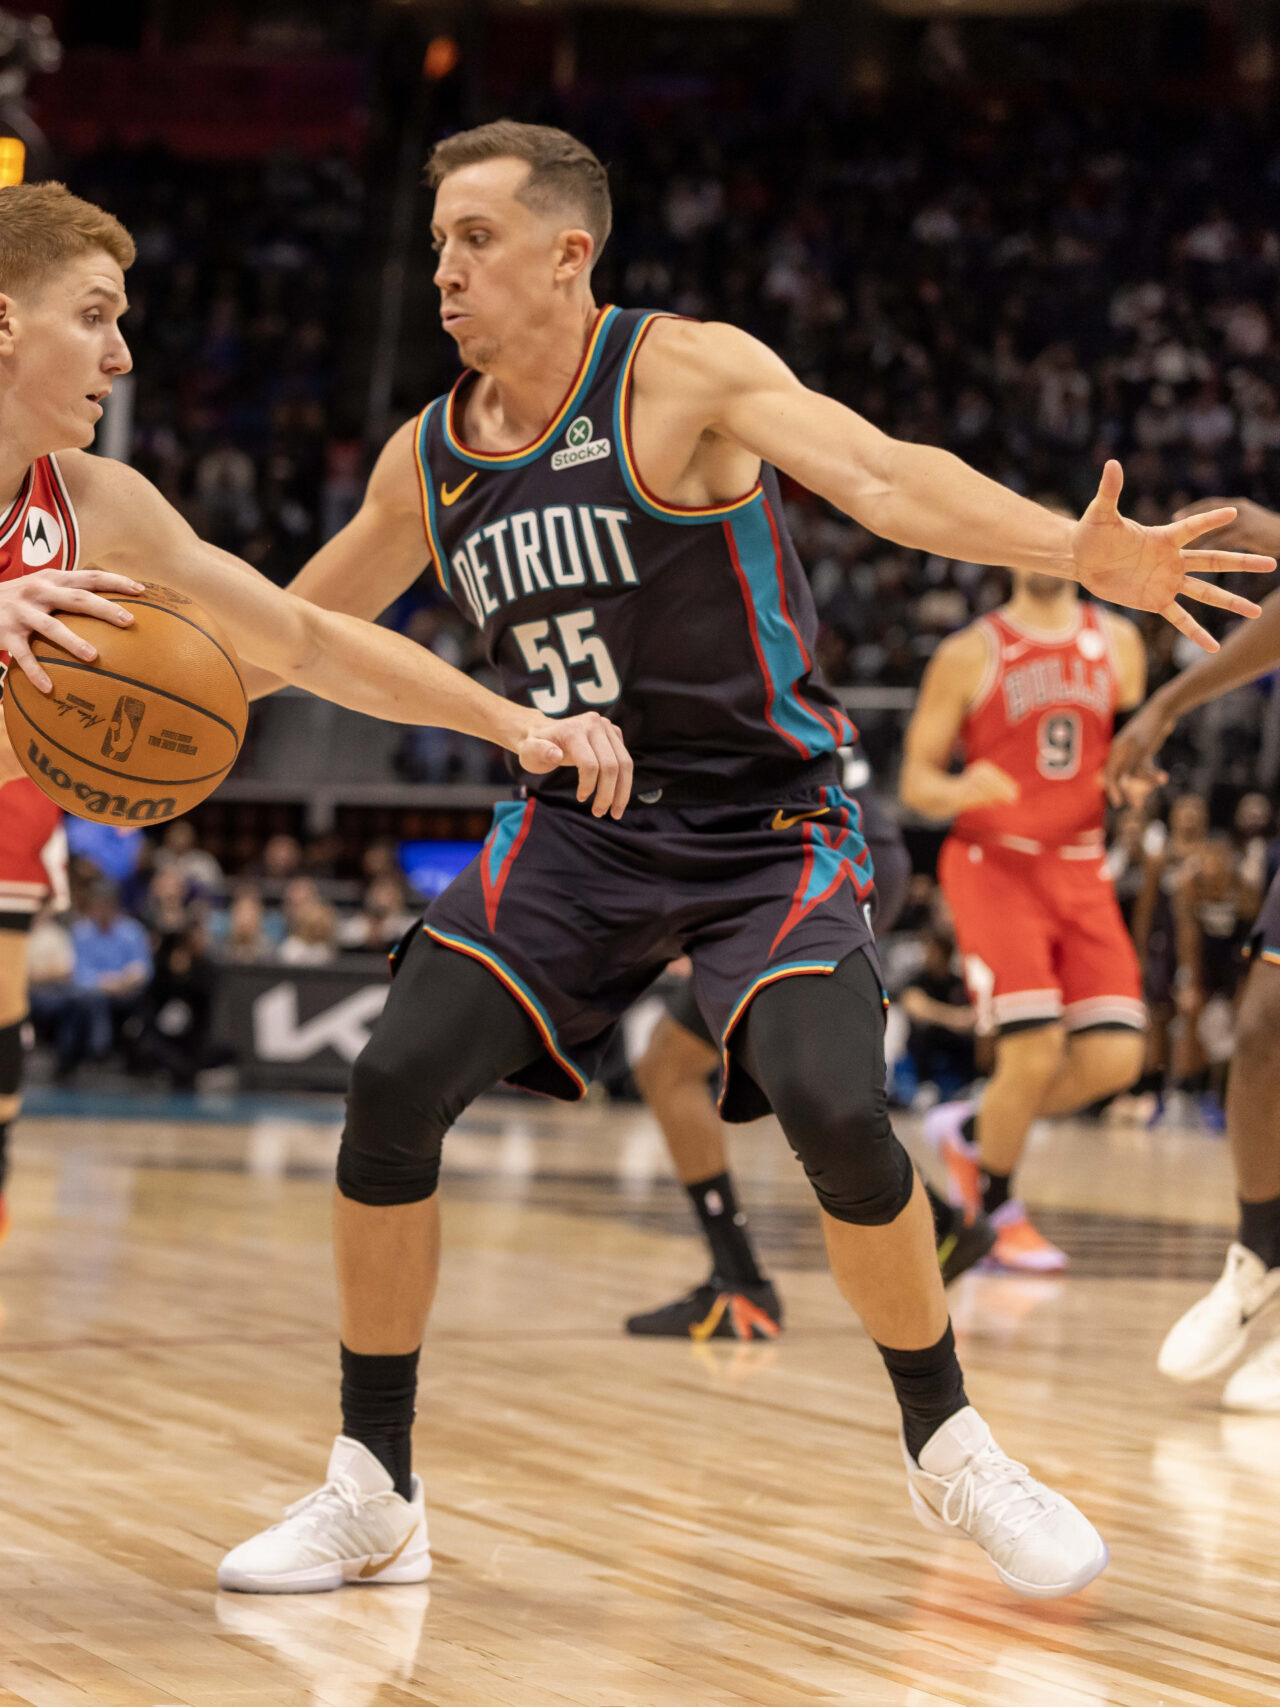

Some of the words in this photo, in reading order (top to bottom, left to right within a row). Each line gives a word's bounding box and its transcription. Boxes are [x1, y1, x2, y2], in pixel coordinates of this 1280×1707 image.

[554, 441, 607, 467] StockX
[451, 505, 640, 631] DETROIT
[512, 607, 621, 715] 55
[27, 738, 177, 820] Wilson
[1036, 708, 1083, 781] 9
